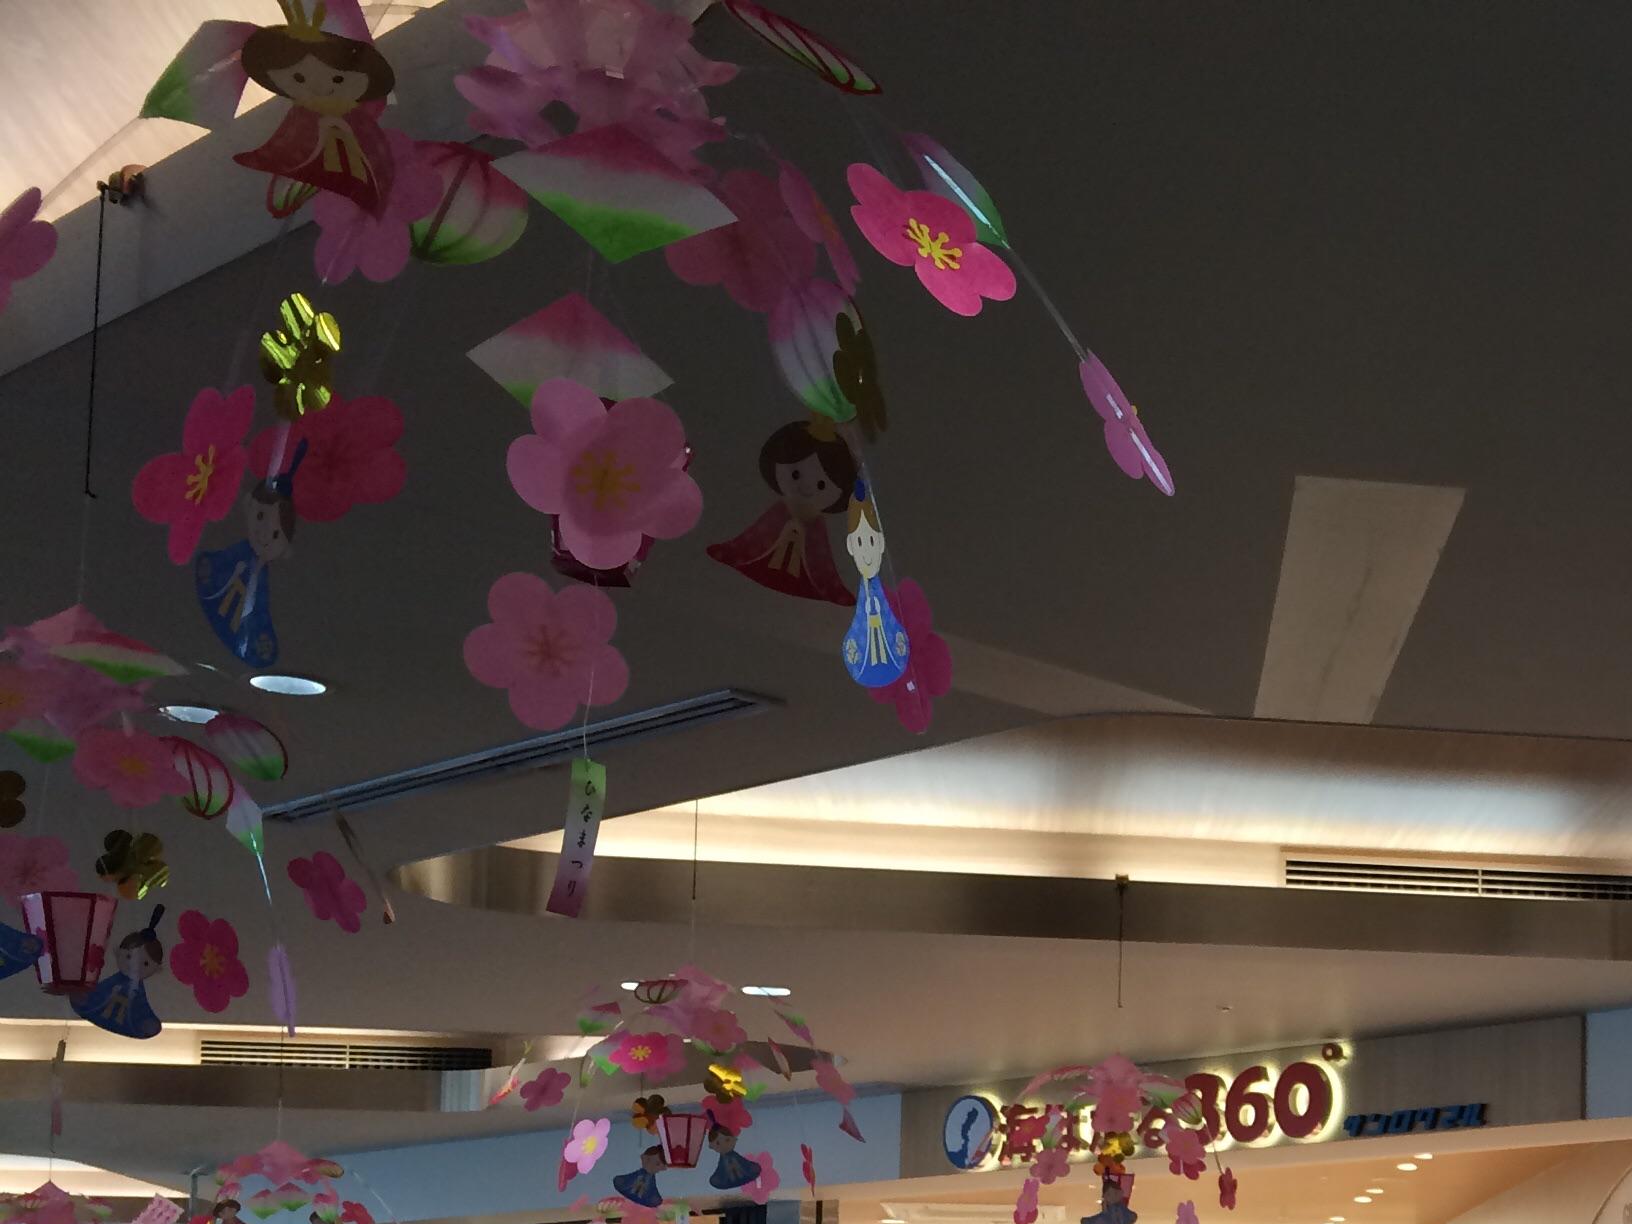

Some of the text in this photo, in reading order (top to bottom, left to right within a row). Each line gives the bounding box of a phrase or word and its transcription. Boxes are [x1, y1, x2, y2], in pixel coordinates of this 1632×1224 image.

[566, 780, 597, 897] ひなまつり
